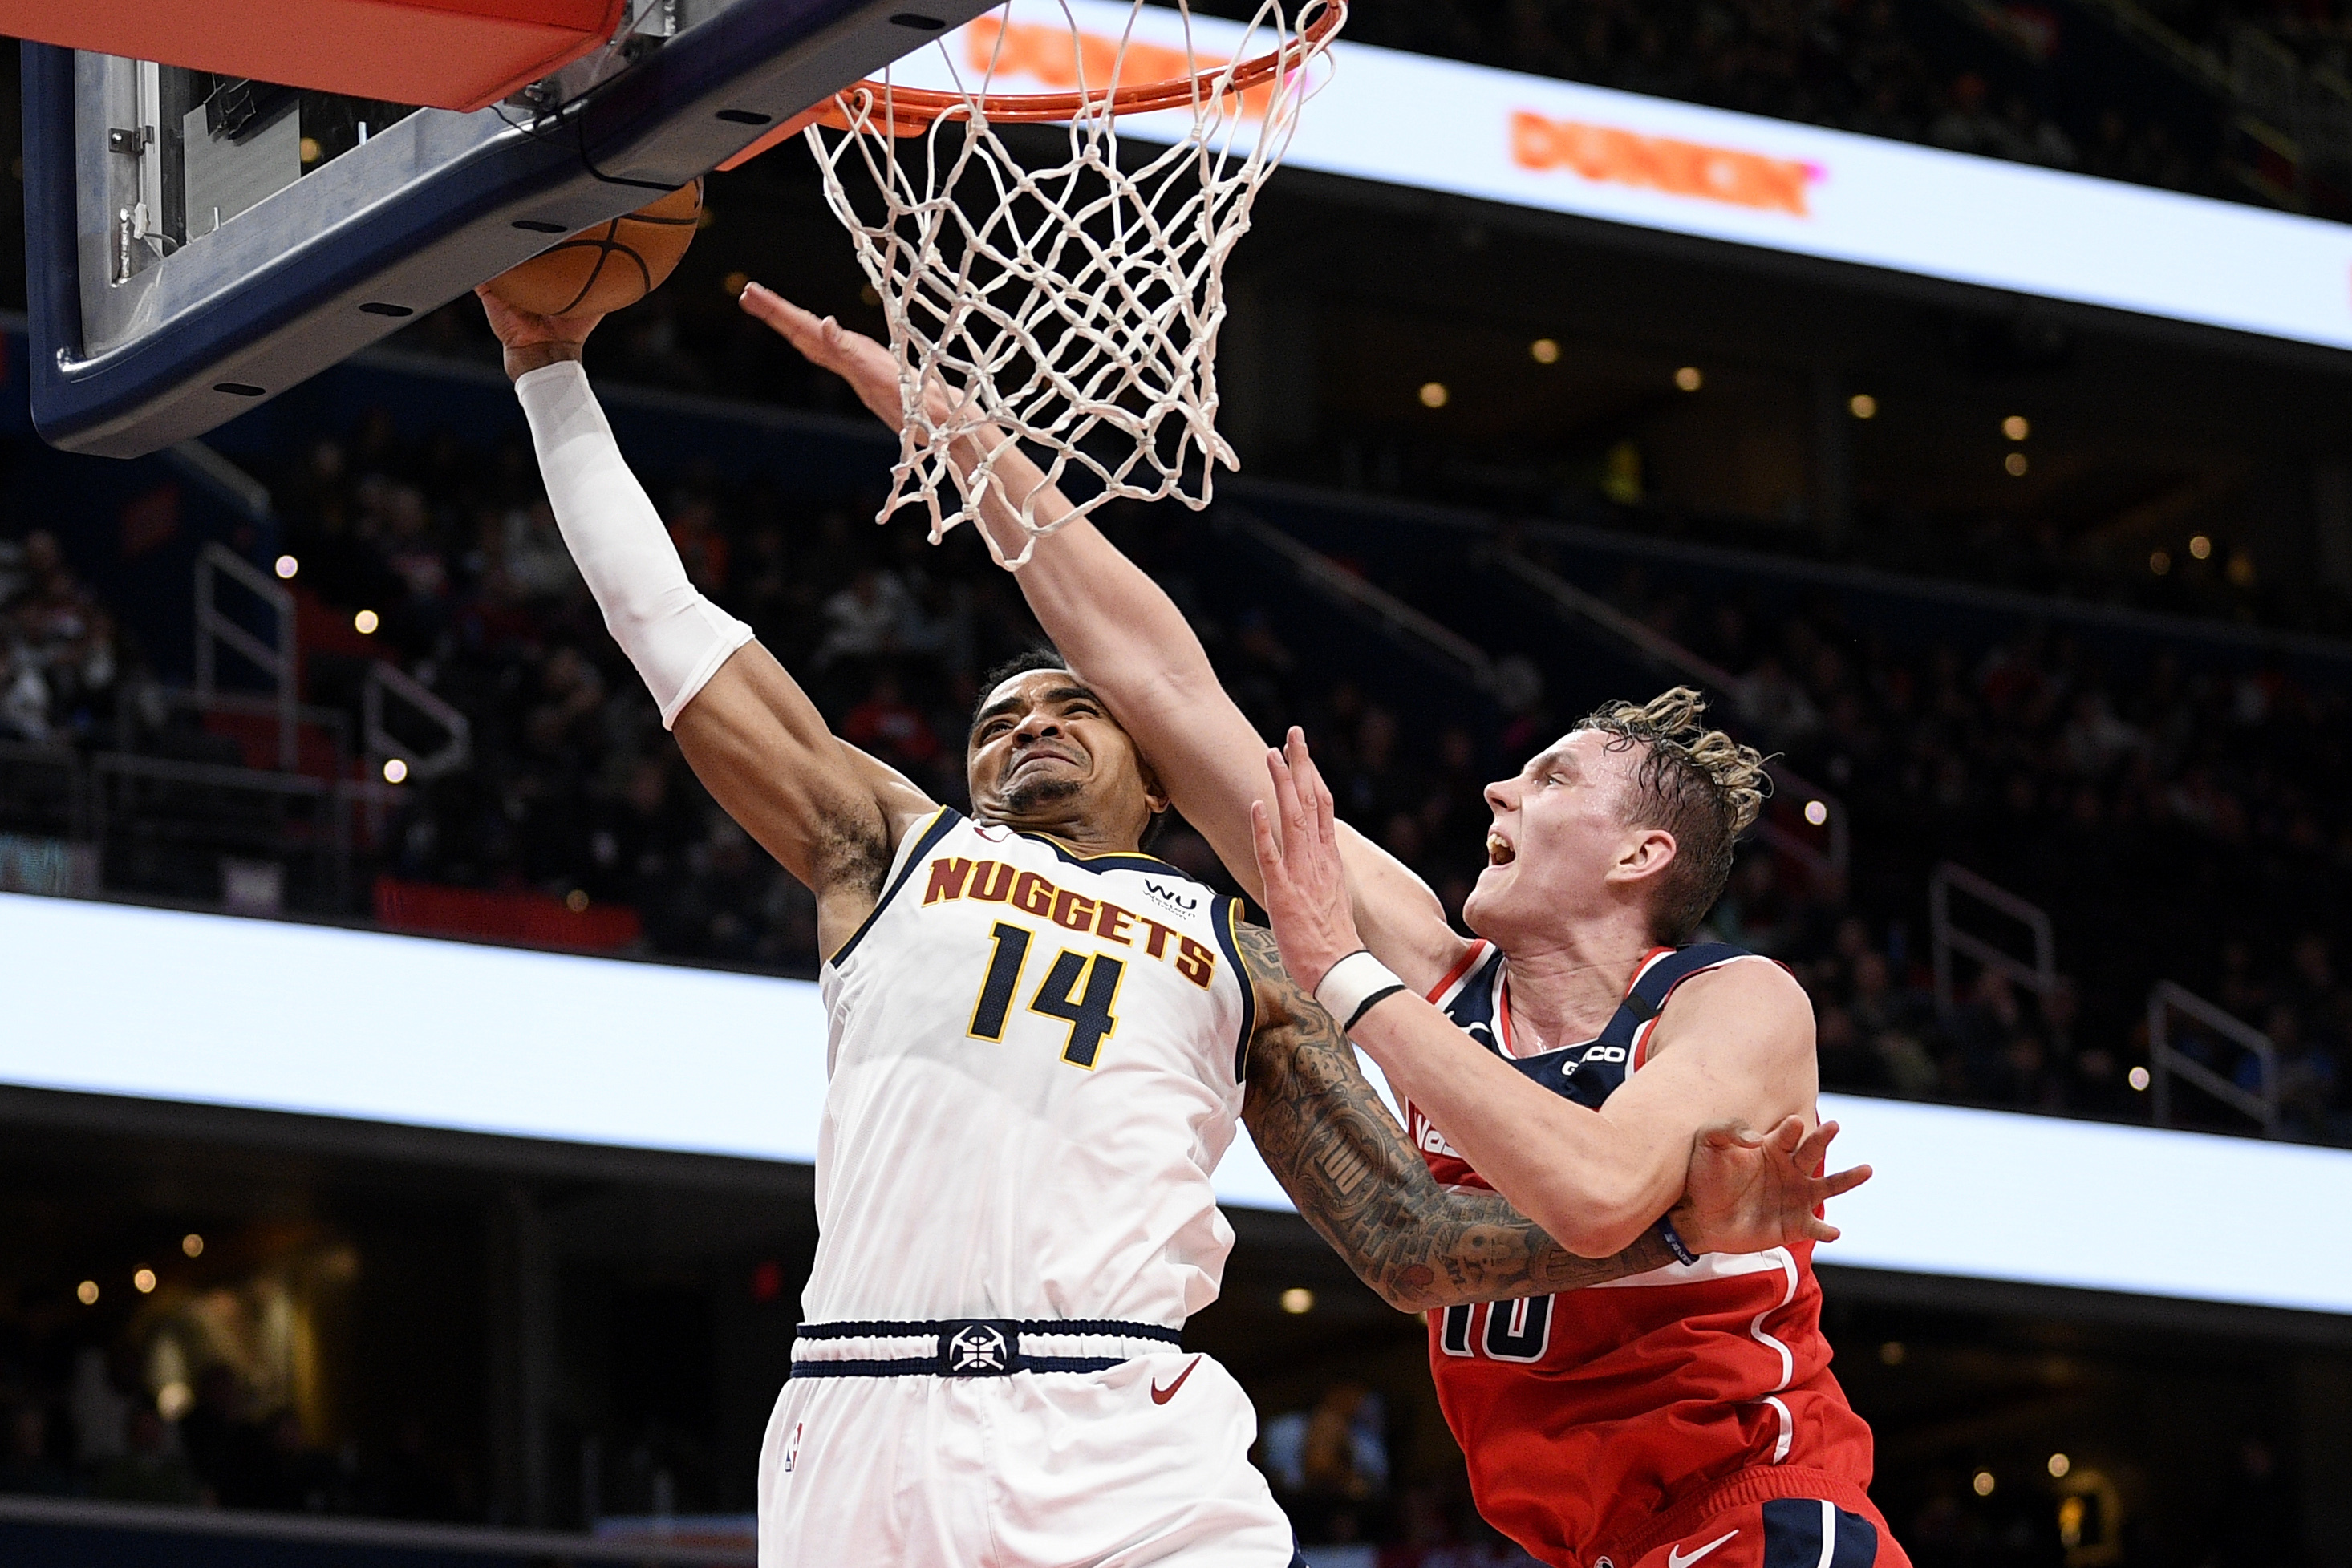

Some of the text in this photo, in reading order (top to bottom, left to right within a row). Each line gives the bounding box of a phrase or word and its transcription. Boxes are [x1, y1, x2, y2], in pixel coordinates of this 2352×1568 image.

[922, 857, 1217, 991] NUGGETS
[1144, 878, 1197, 910] WU
[966, 918, 1128, 1071] 14
[1561, 1045, 1626, 1076] GCO
